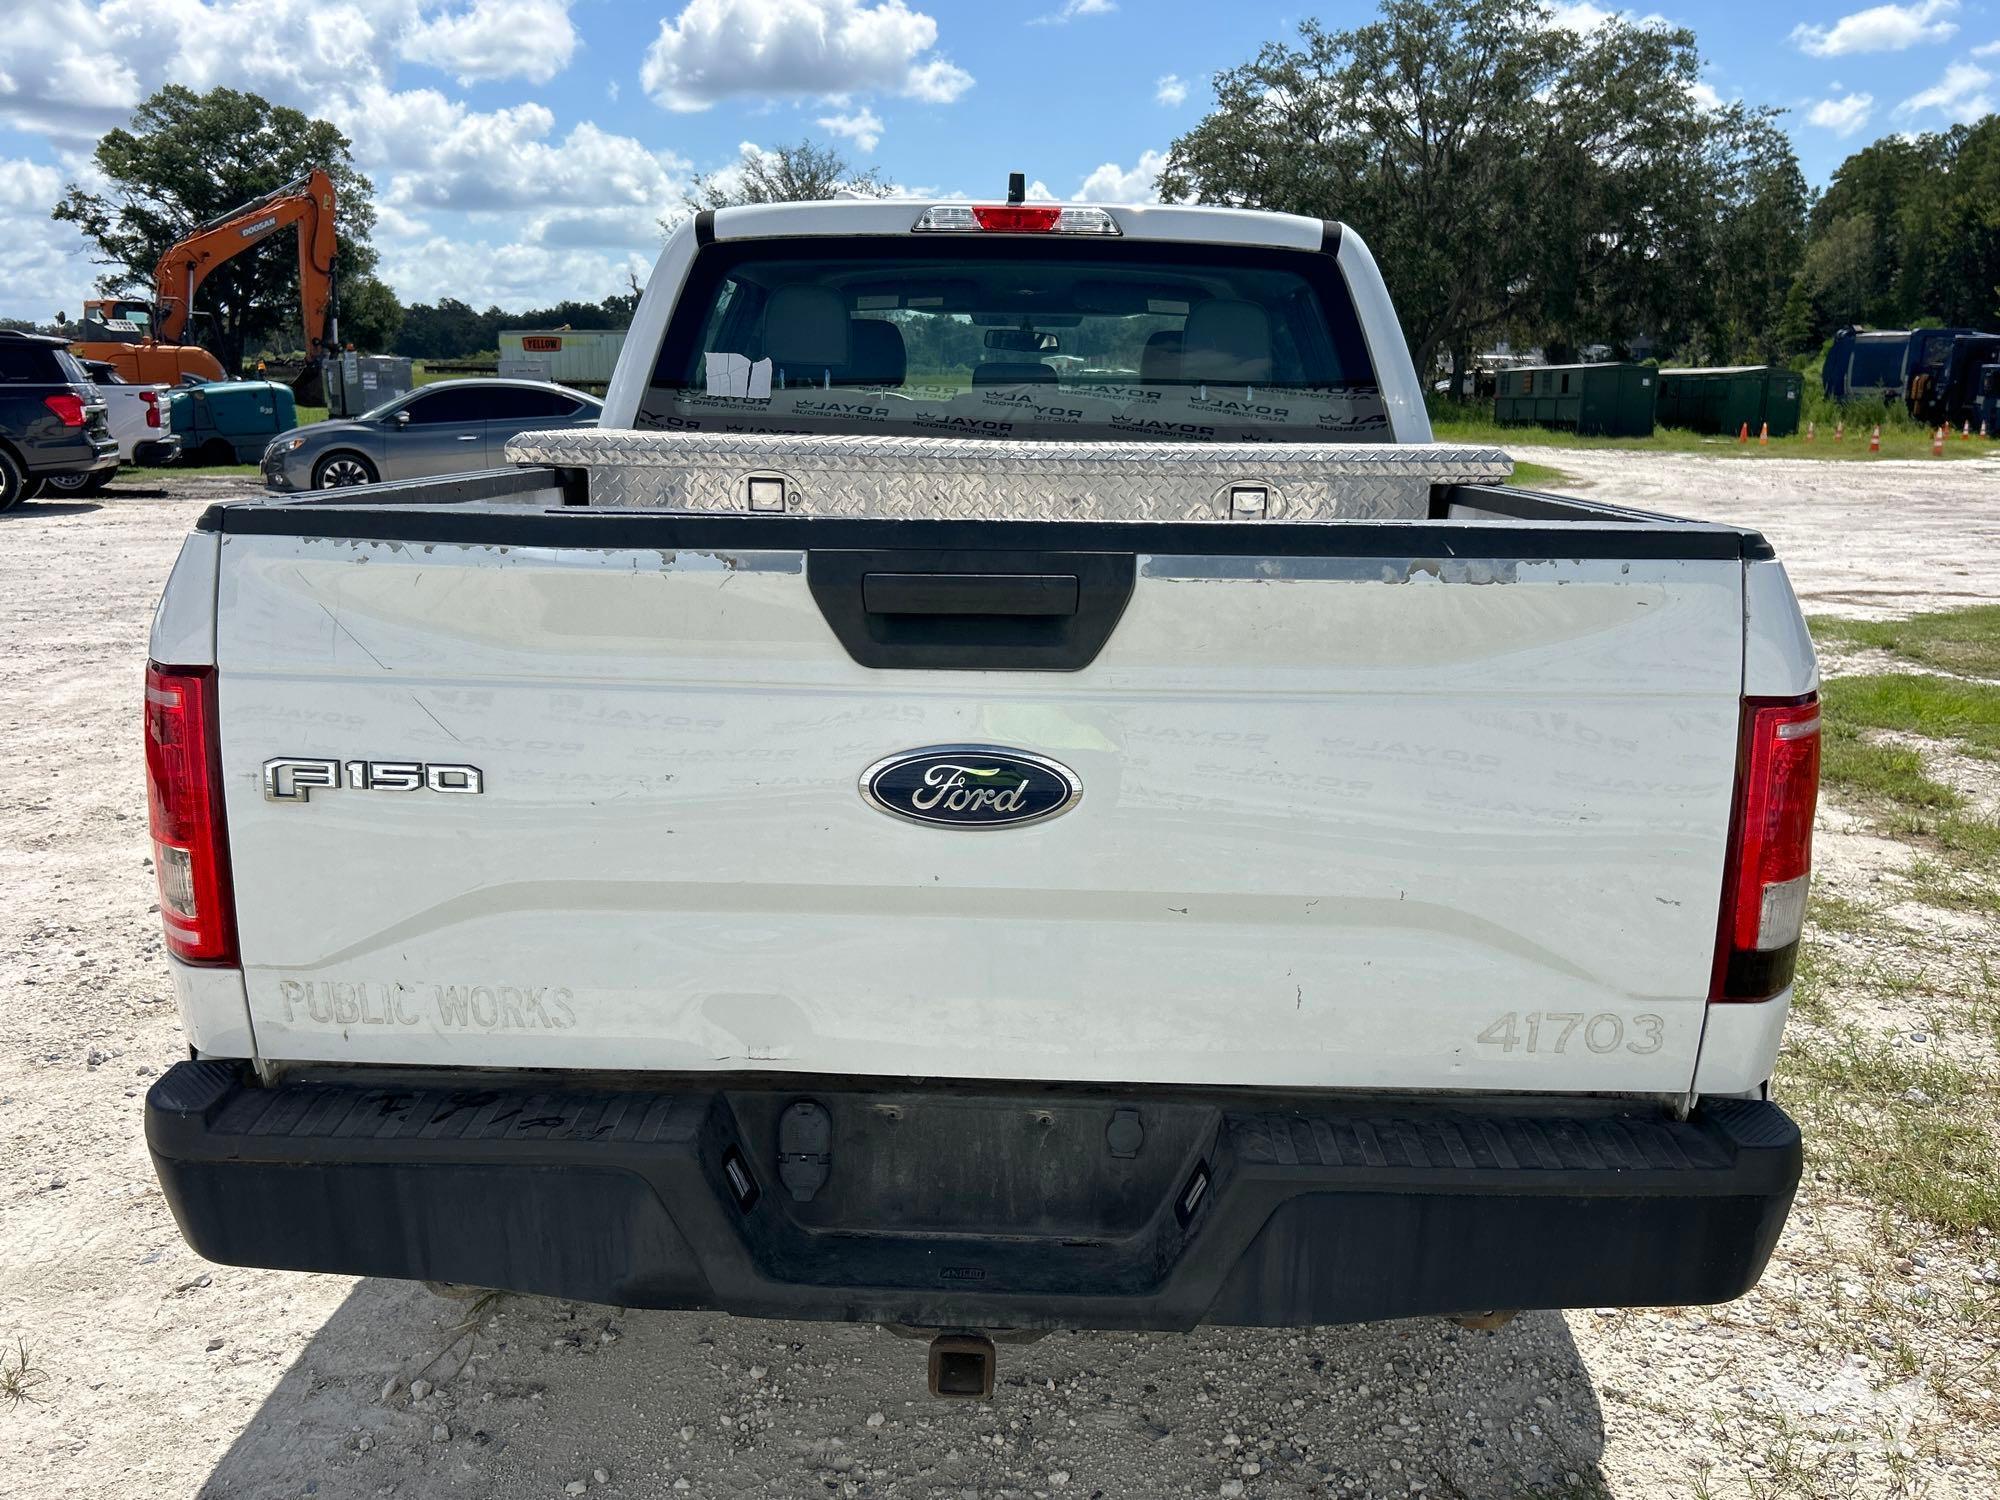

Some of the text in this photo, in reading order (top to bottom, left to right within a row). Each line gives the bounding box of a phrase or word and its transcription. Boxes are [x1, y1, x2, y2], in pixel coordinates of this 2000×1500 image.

[242, 217, 276, 236] DOOSAN
[527, 339, 557, 349] YELLOW
[912, 764, 1029, 812] Ford
[280, 981, 577, 1029] PUBLIC WORKS
[1477, 1012, 1664, 1055] 41703
